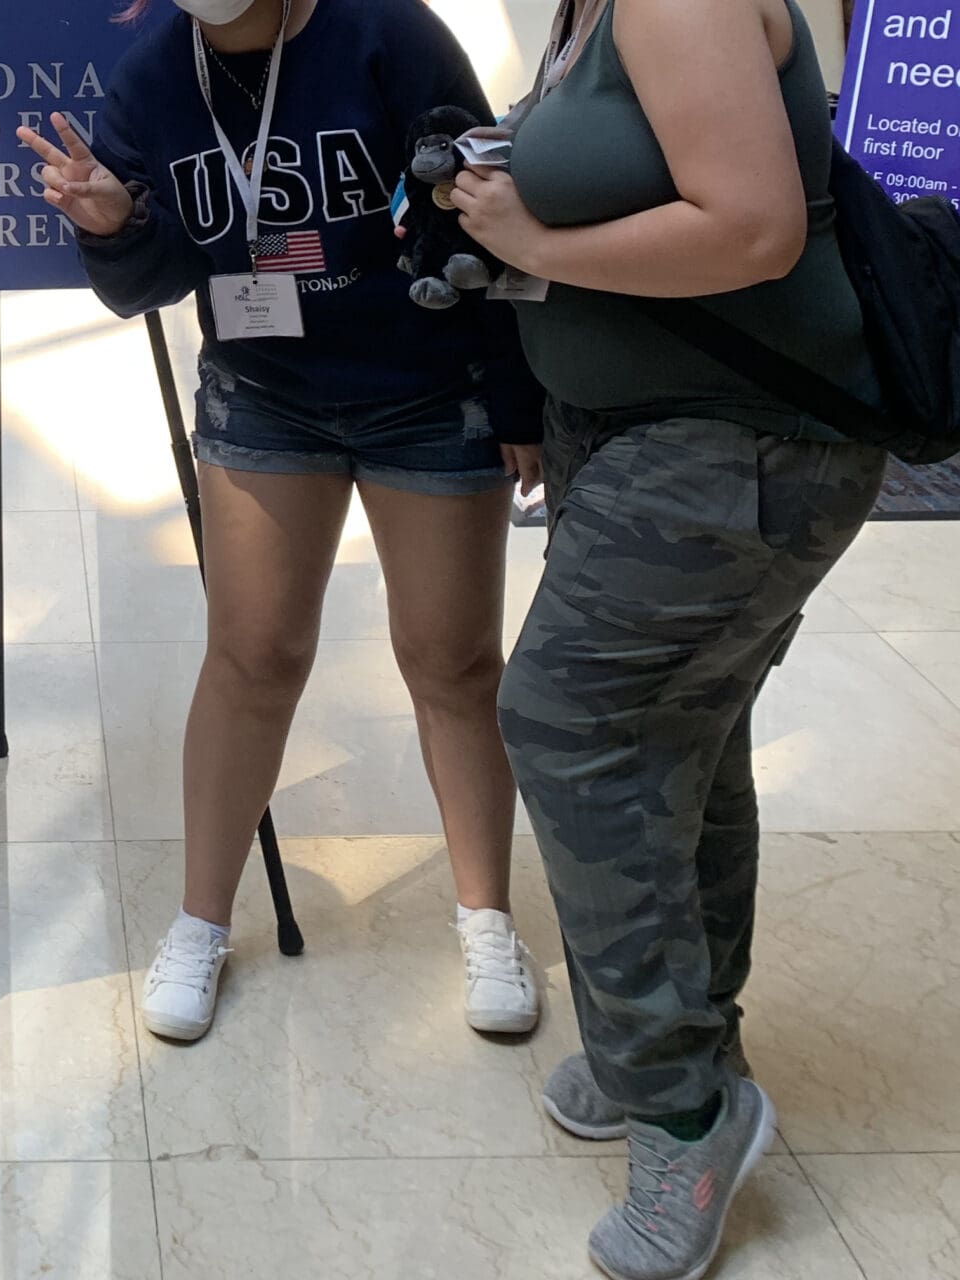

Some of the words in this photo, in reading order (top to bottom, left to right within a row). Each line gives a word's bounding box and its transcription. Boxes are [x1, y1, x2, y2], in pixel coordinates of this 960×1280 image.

[883, 10, 952, 40] and
[867, 114, 941, 135] Located
[946, 124, 960, 137] o
[863, 137, 897, 156] first
[902, 141, 944, 160] floor
[170, 129, 391, 245] USA
[886, 173, 947, 191] 09:00am
